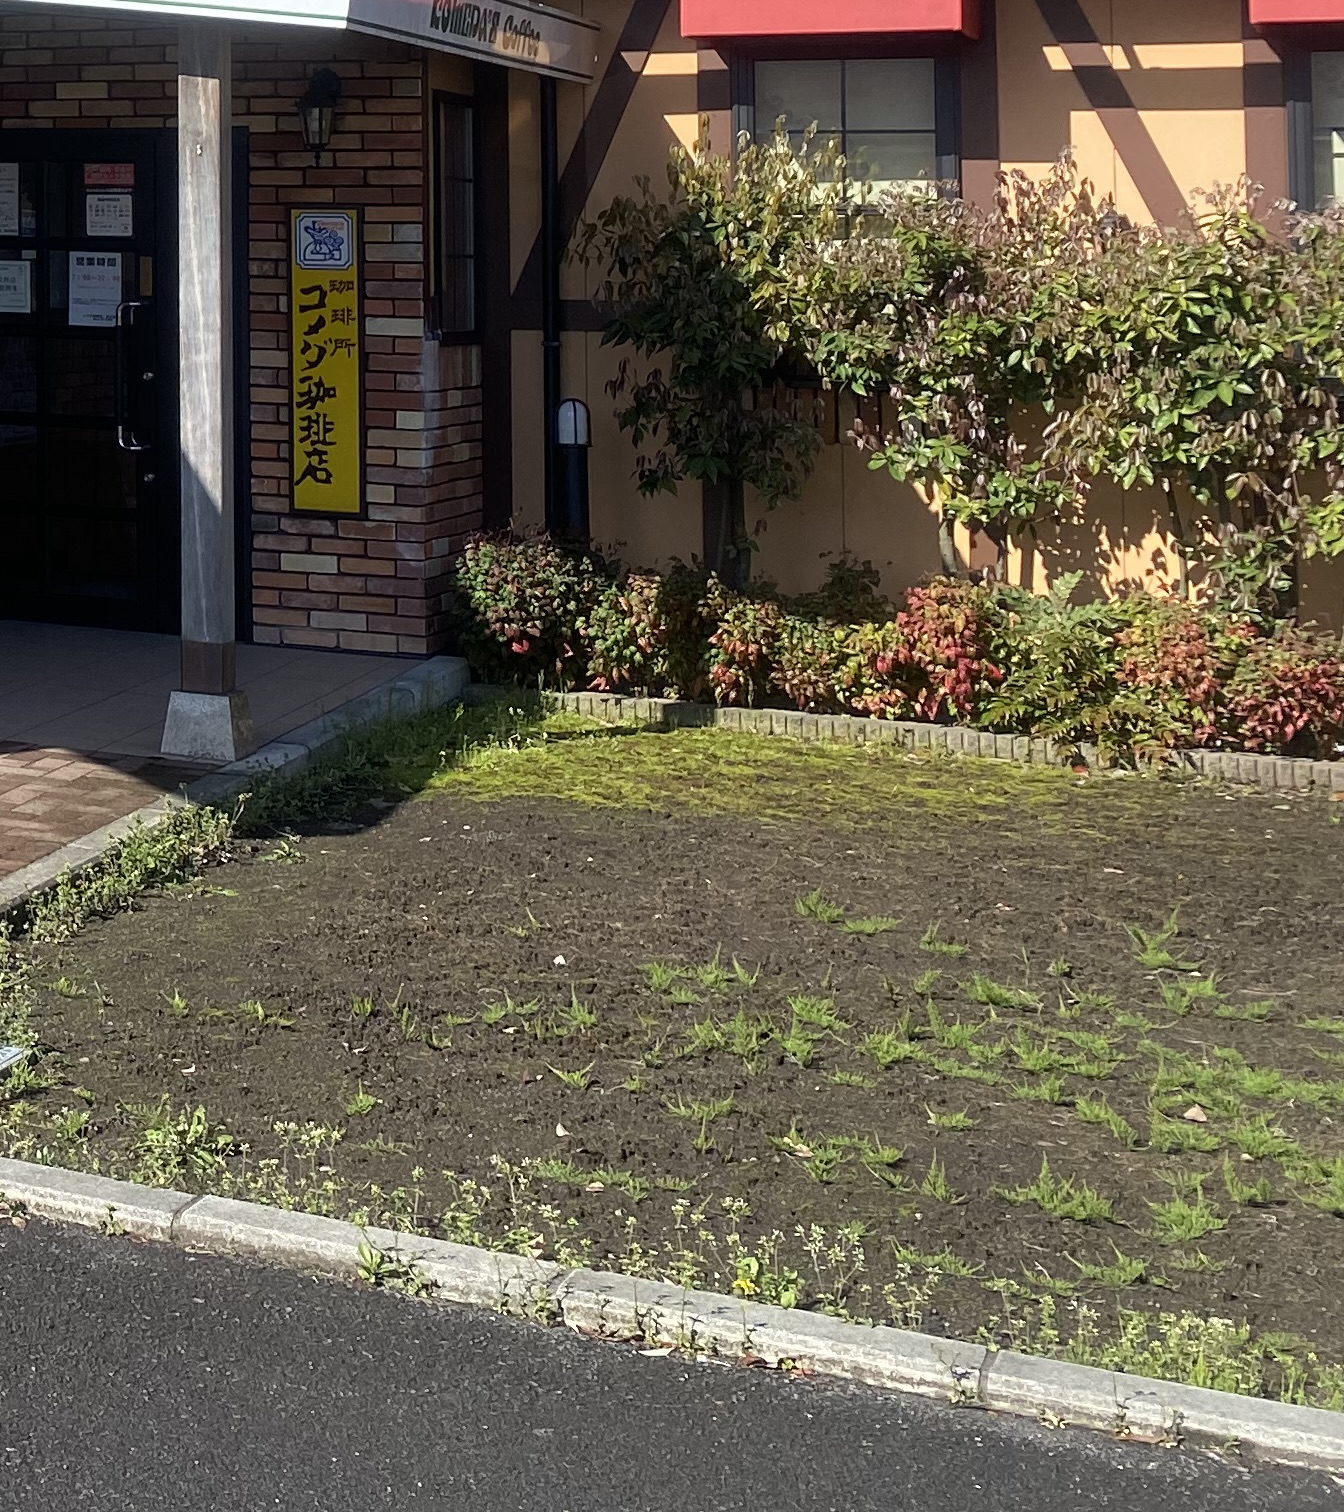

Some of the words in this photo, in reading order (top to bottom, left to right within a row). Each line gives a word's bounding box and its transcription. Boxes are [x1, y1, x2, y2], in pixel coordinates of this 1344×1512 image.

[294, 284, 337, 486] コメダ珈琲店
[329, 279, 357, 360] 珈琲所
